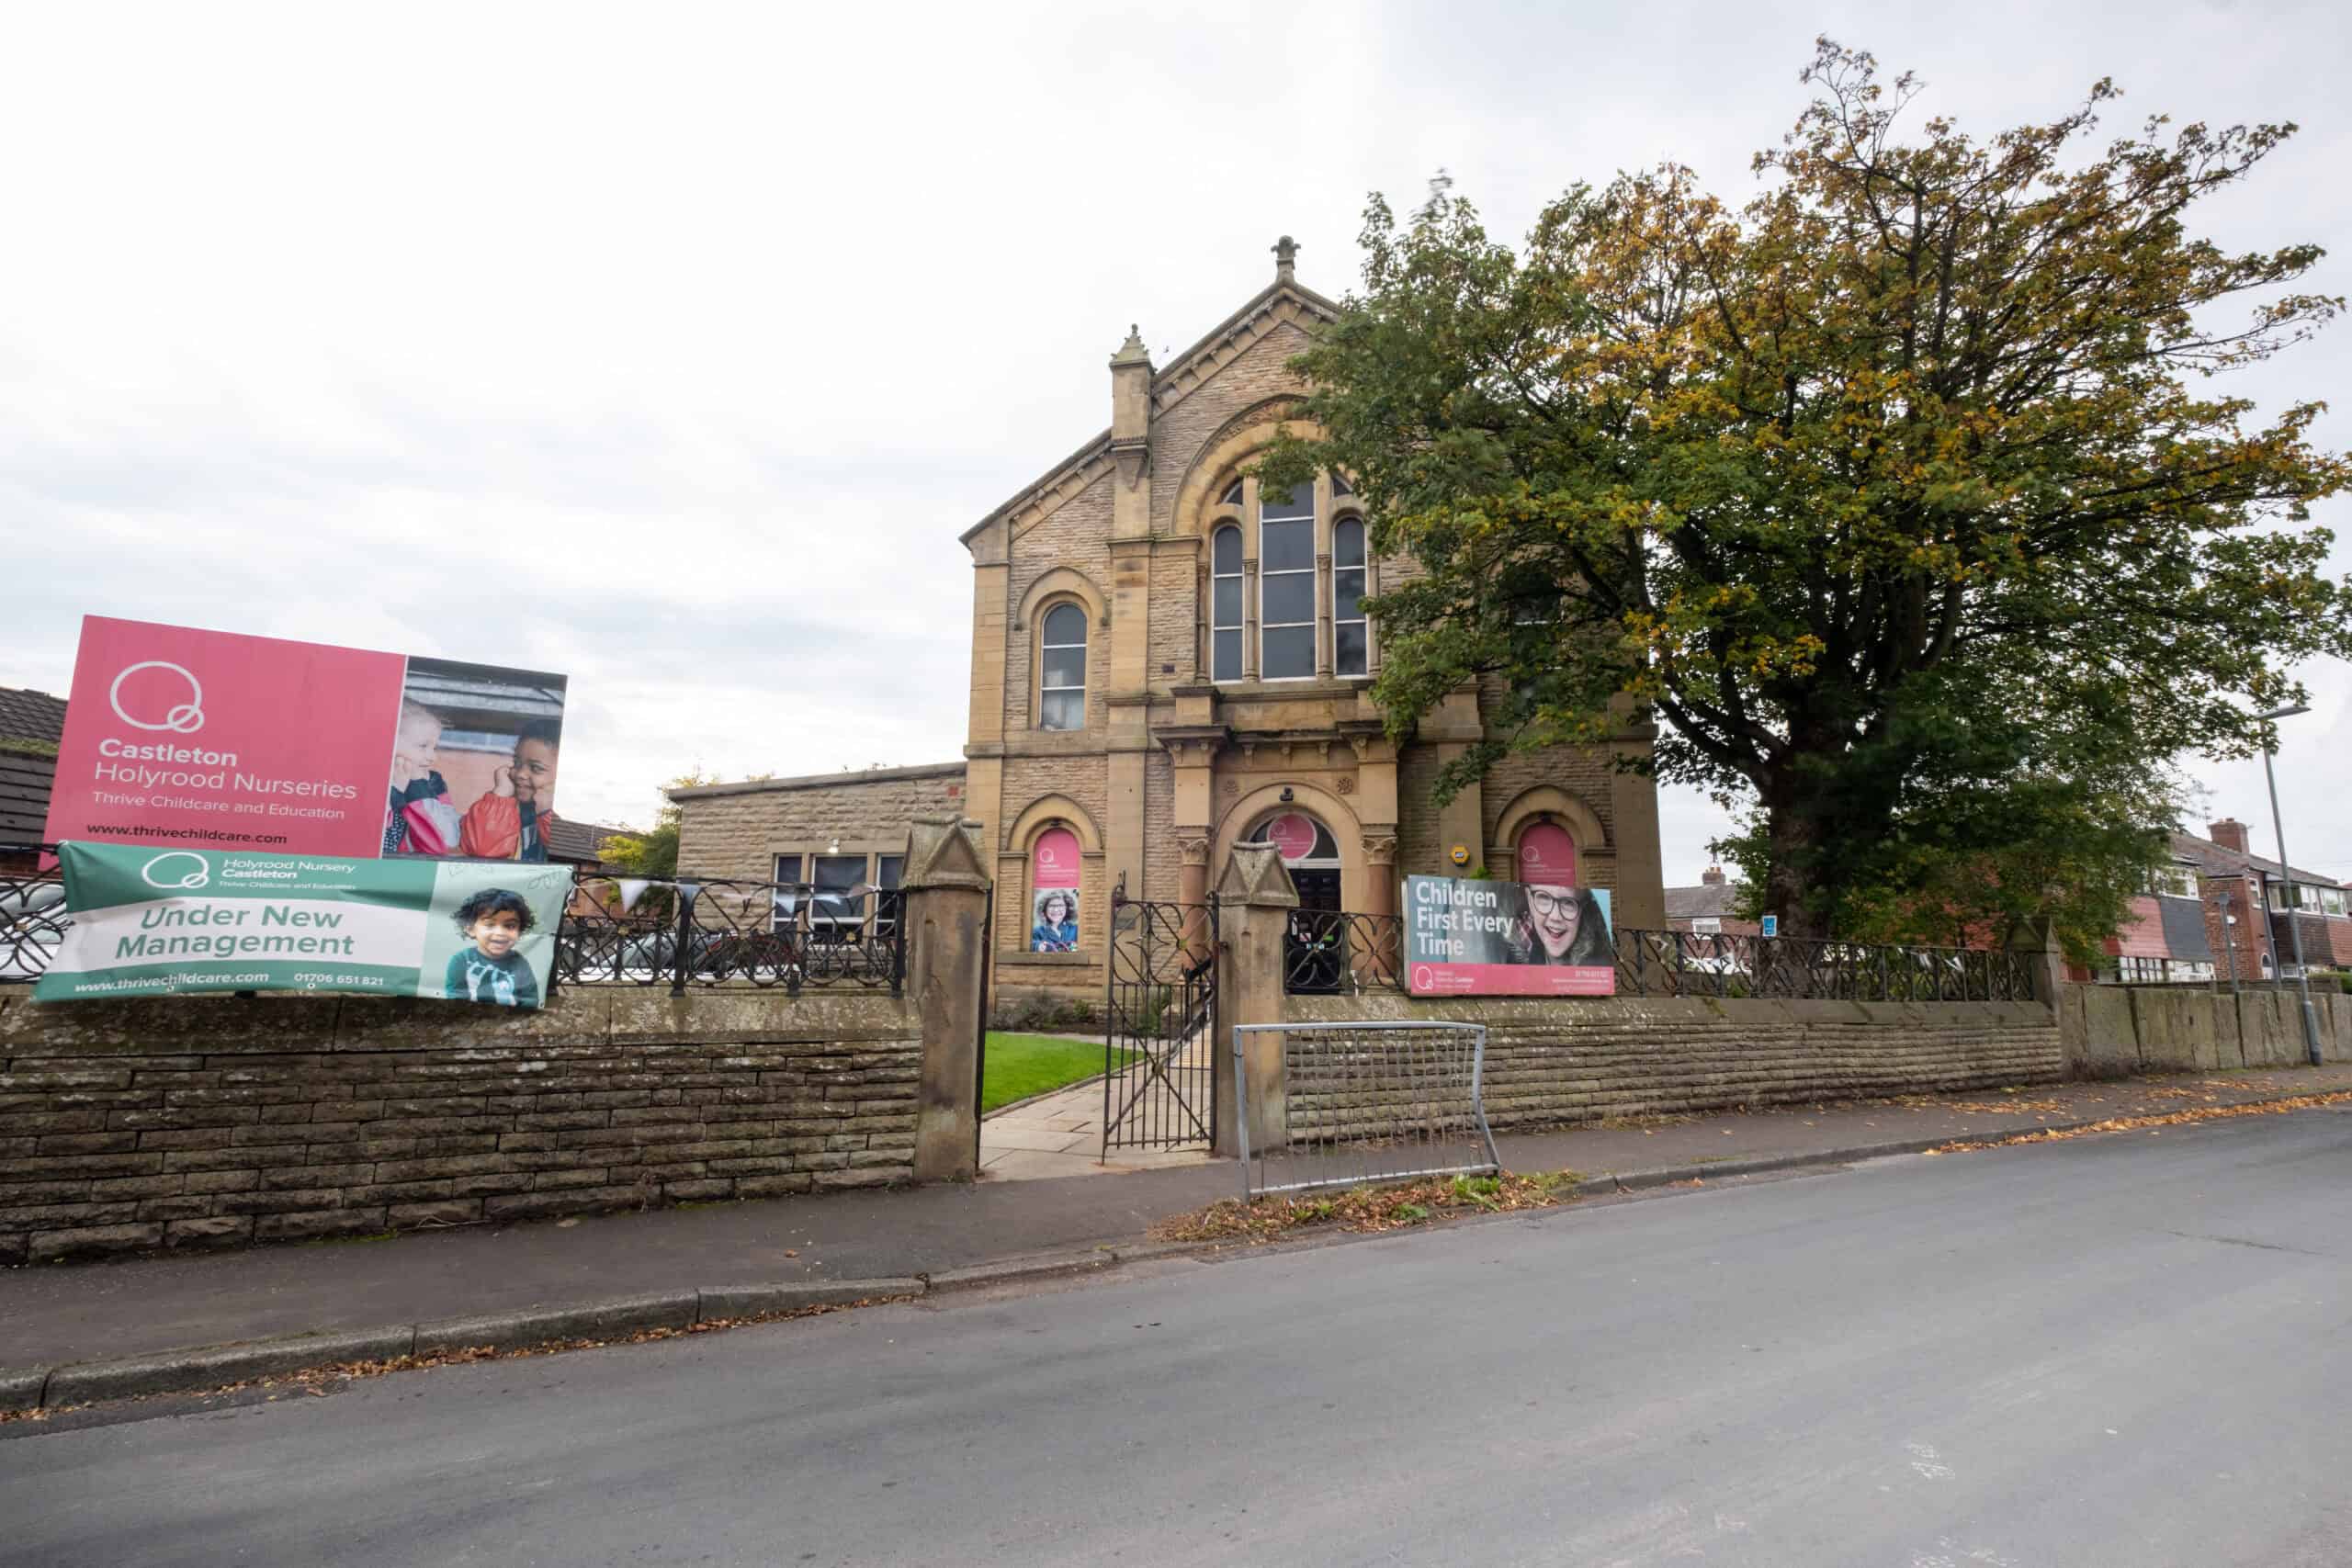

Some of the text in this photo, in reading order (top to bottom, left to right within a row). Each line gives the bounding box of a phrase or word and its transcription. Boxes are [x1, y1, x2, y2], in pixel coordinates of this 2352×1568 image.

[98, 738, 238, 767] Castleton
[95, 761, 357, 799] Holyrood Nurseries
[93, 791, 345, 819] Thrive Childcare and Education
[87, 824, 288, 844] www.thrivechildcare.com
[221, 869, 298, 879] Castleton
[223, 859, 356, 874] Holyrood Nursery
[1416, 881, 1498, 909] Children
[141, 904, 343, 930] Under New
[1417, 906, 1515, 939] First Every
[115, 933, 355, 959] Management
[1416, 931, 1464, 956] Time
[74, 972, 270, 993] www.thrivechildcare.com
[293, 973, 334, 983] 01706
